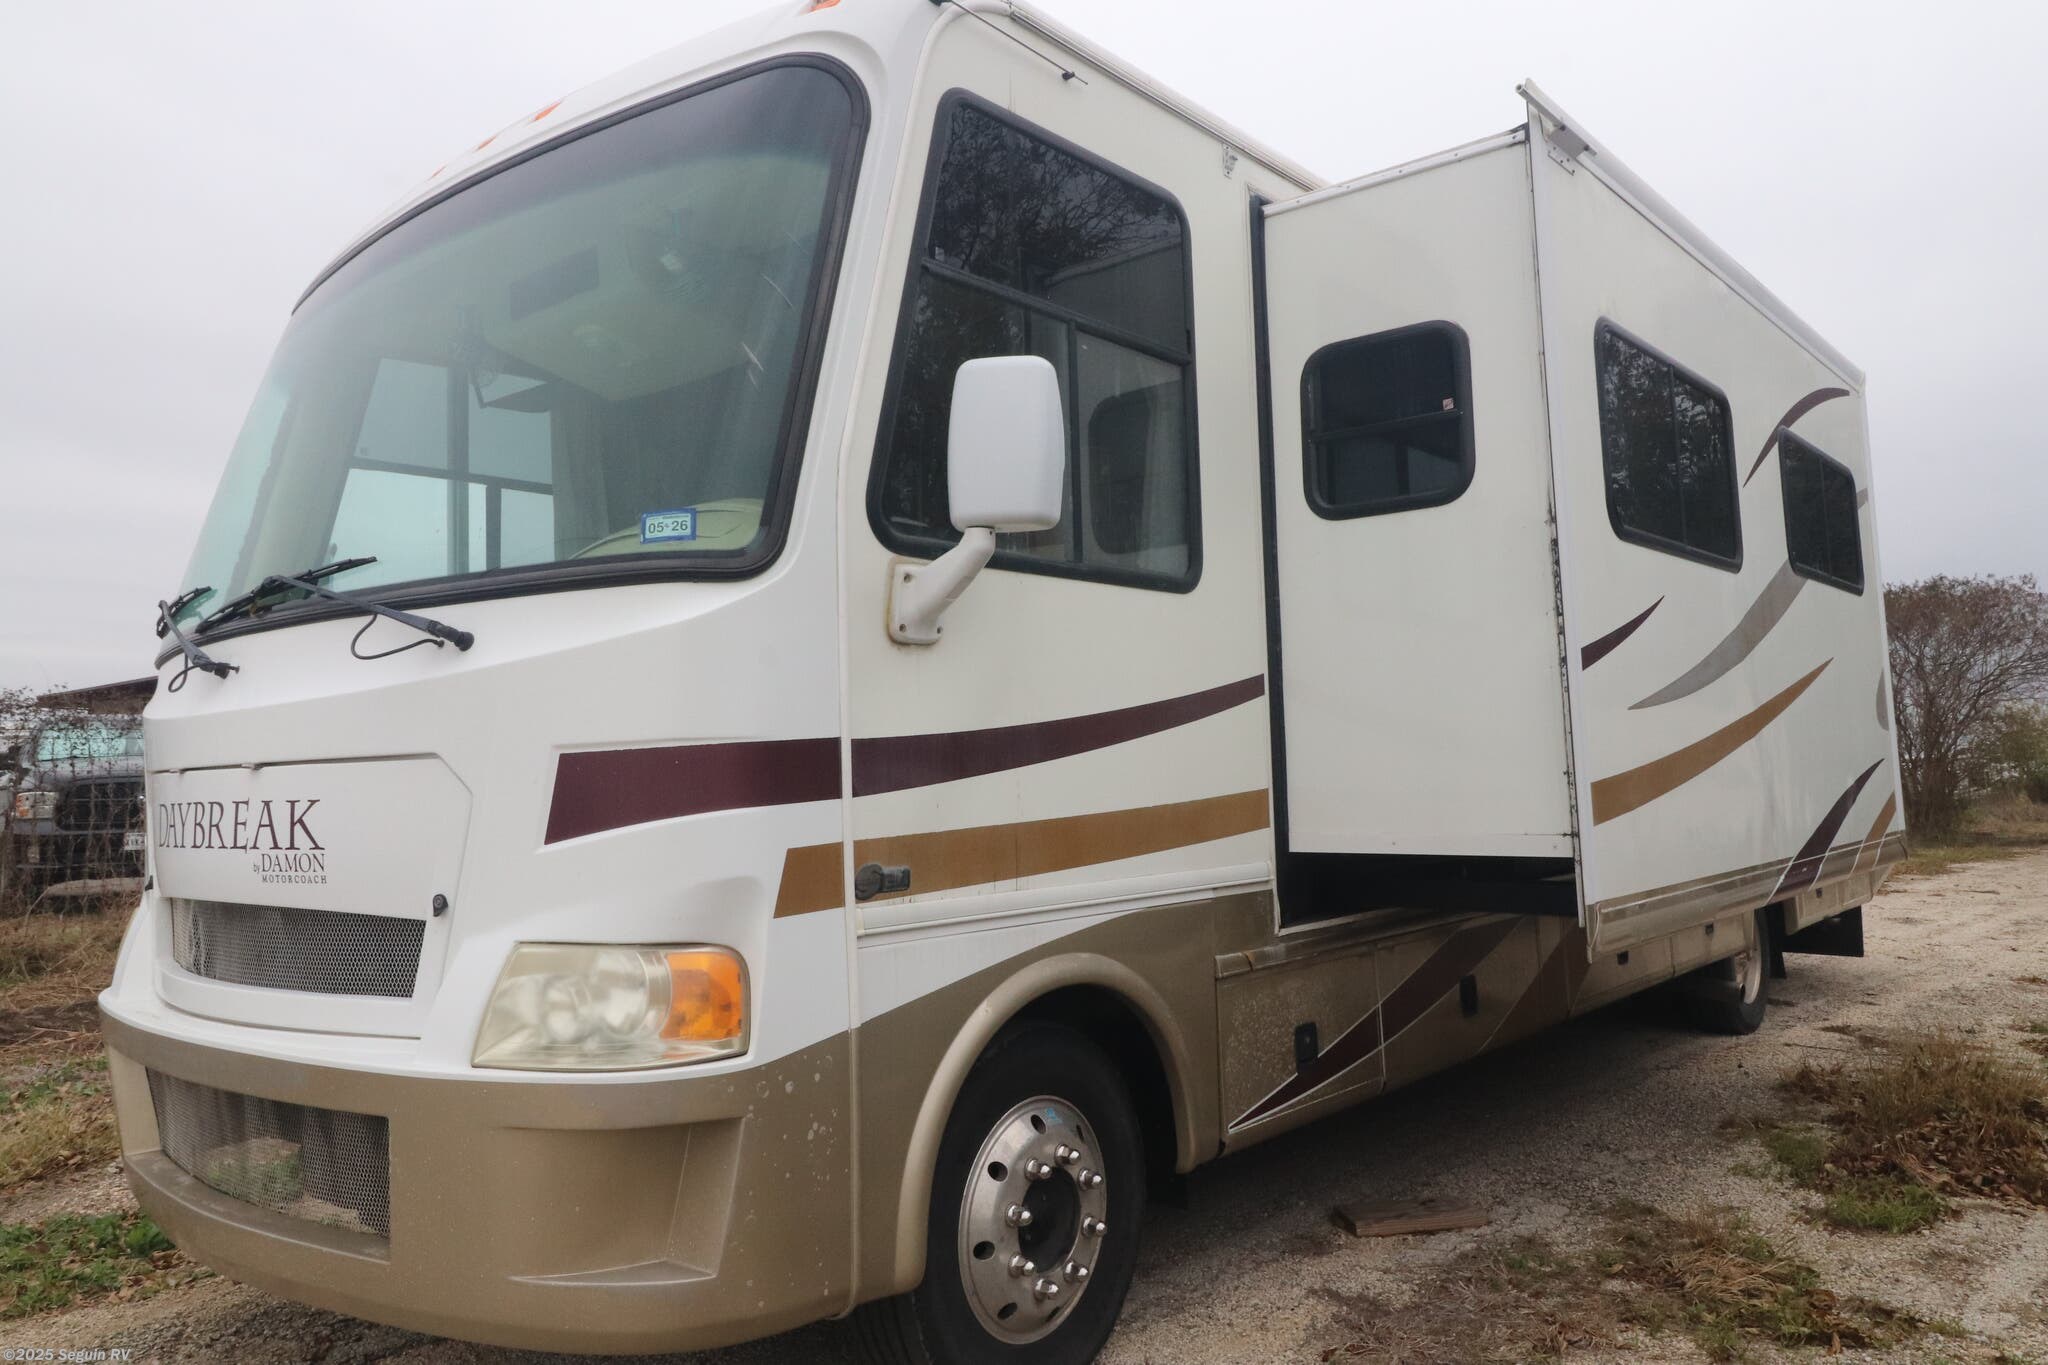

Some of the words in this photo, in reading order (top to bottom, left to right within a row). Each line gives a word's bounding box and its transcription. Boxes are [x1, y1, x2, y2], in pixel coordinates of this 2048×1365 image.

[159, 798, 325, 853] DAYBREAK
[253, 862, 260, 874] by
[260, 853, 325, 873] DAMON
[261, 875, 327, 884] MOTORCOACH
